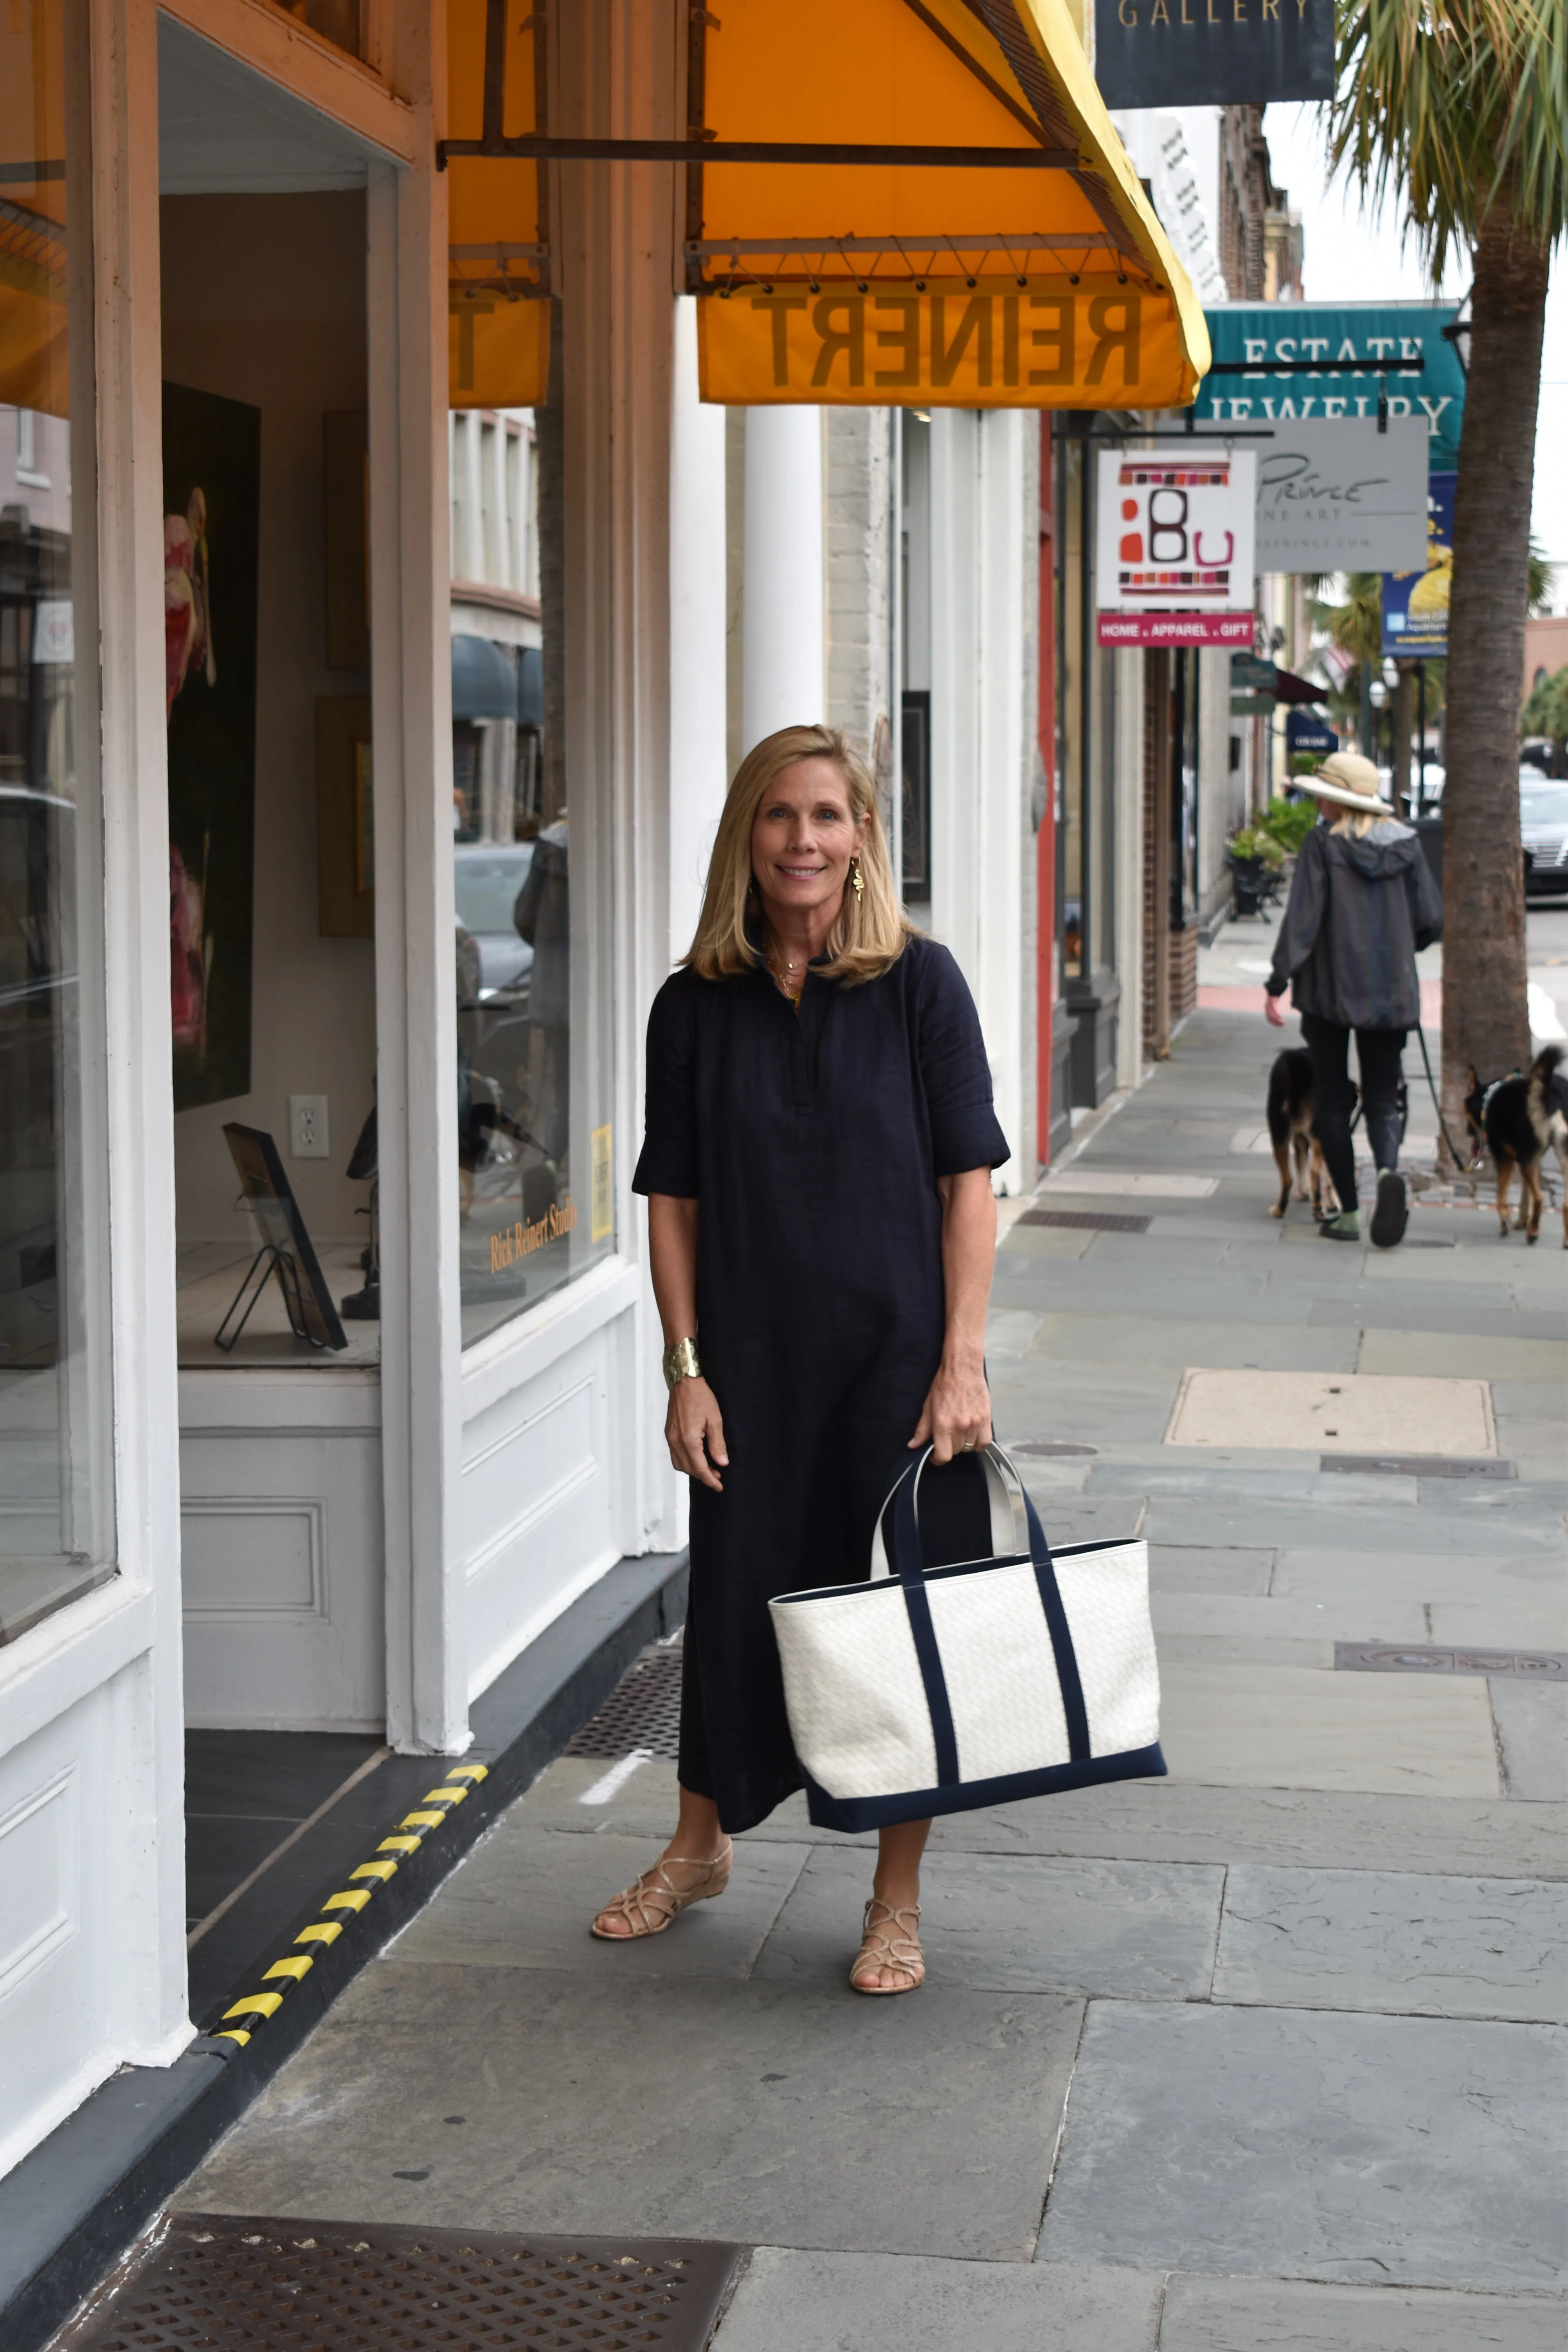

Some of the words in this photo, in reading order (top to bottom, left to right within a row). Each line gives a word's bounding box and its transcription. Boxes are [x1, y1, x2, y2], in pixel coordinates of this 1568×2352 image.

[1118, 0, 1307, 27] GALLERY
[1242, 338, 1424, 379] ESTATE
[1302, 509, 1341, 521] ART
[1101, 623, 1139, 637] HOME
[1151, 622, 1209, 637] APPAREL
[1220, 622, 1249, 637] GIFT
[490, 1228, 513, 1274] Rick
[515, 1209, 548, 1260] Reinert
[550, 1196, 577, 1241] Studio
